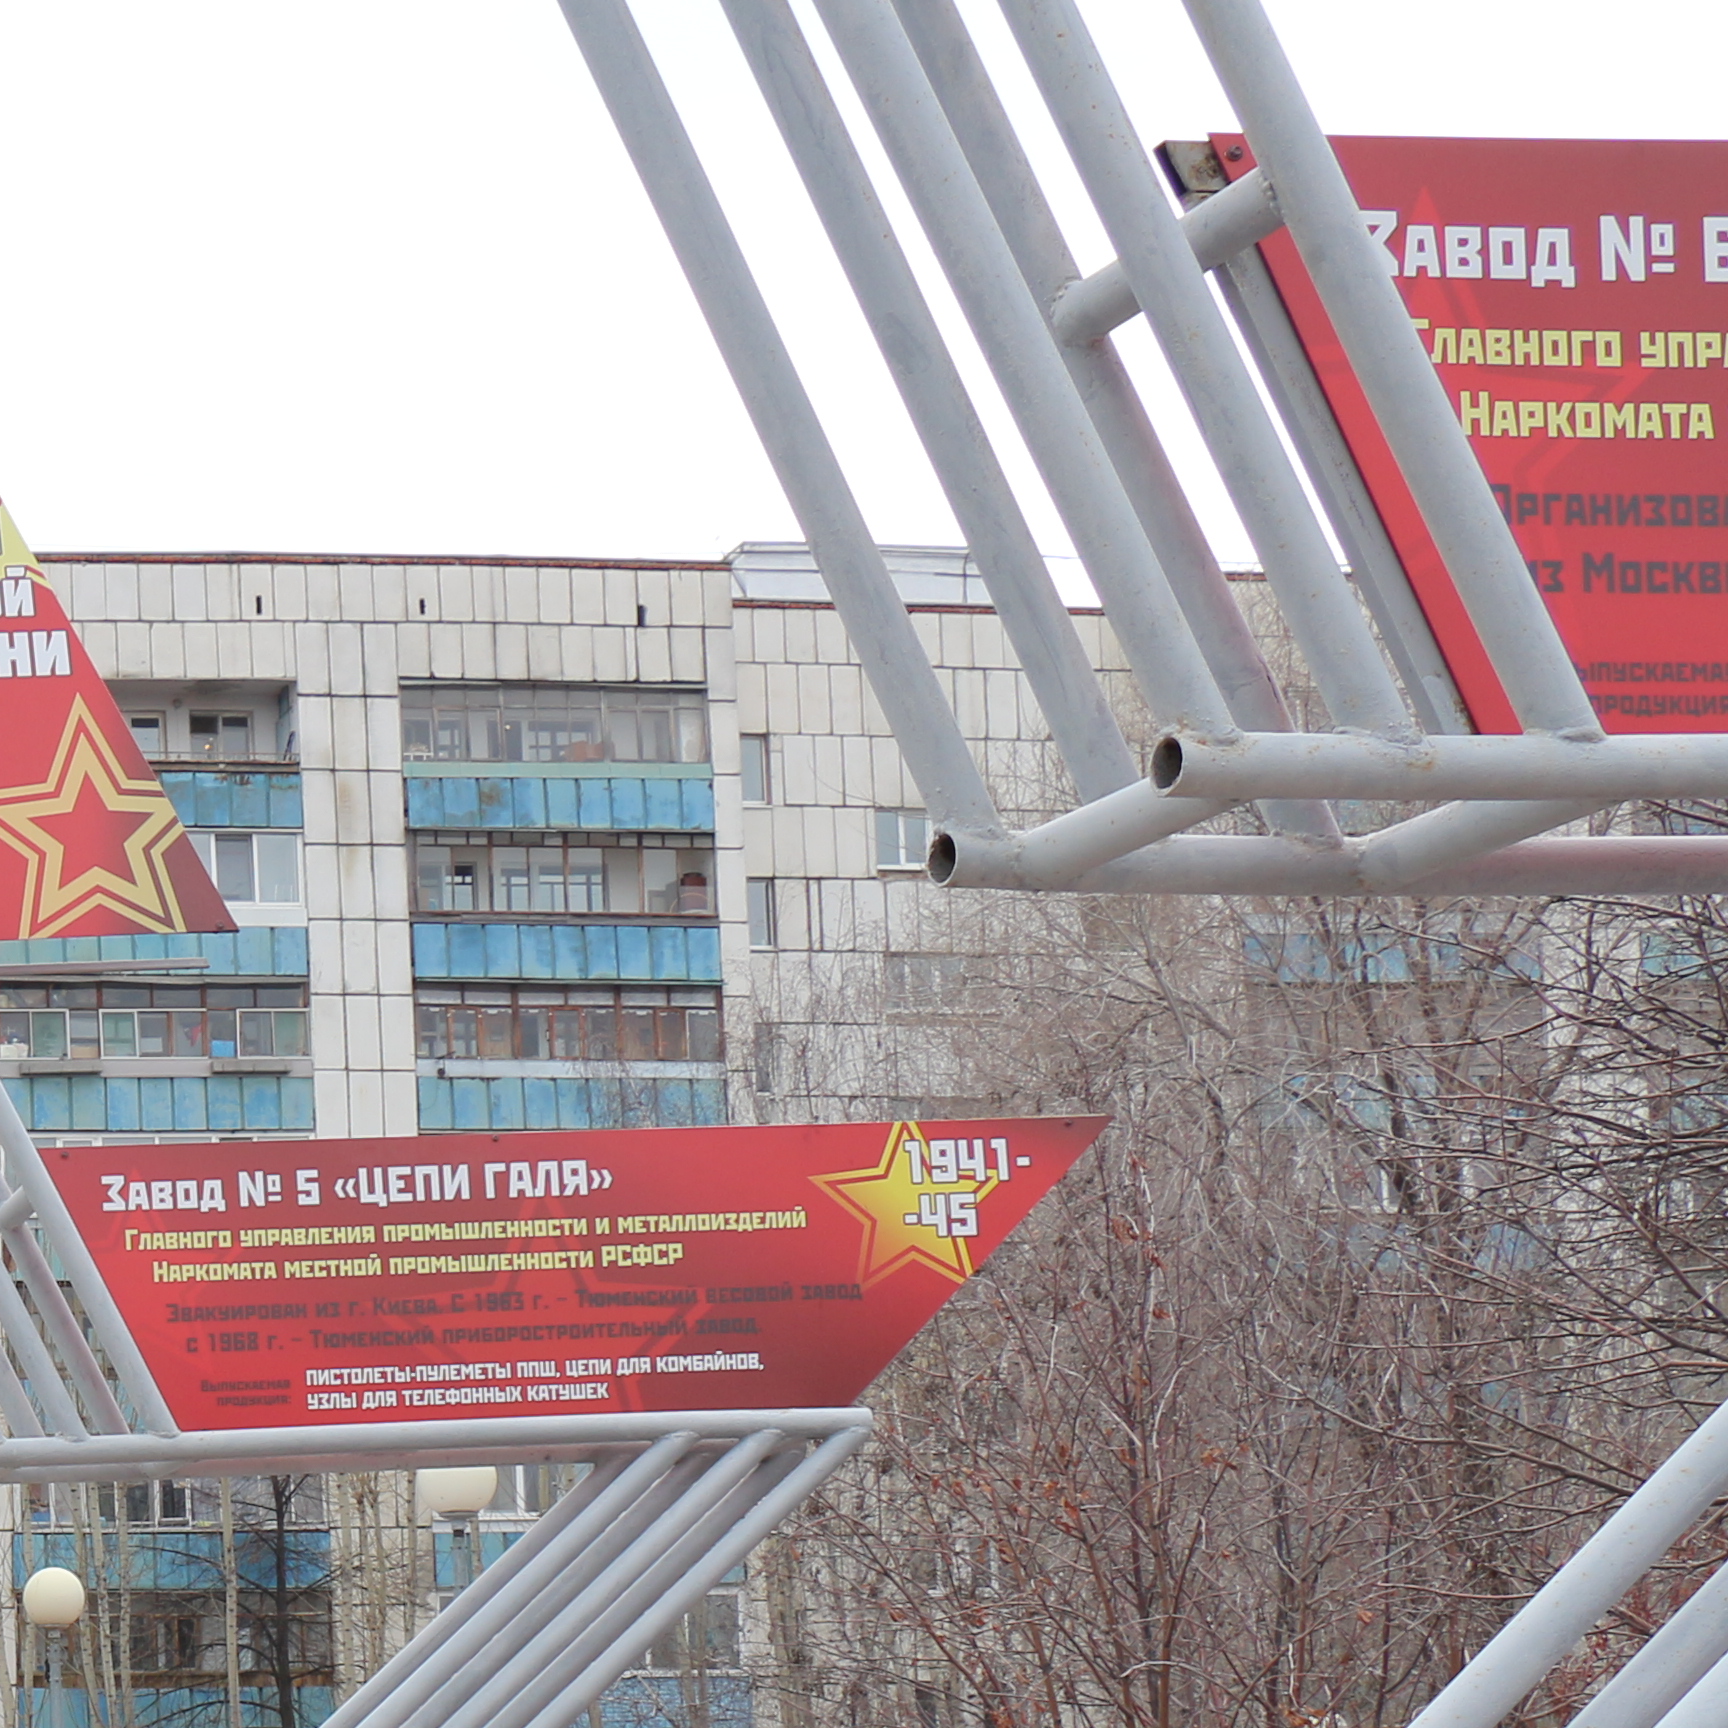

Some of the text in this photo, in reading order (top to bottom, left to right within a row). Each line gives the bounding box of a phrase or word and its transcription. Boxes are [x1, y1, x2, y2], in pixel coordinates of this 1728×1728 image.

[1599, 214, 1676, 281] №
[1410, 317, 1728, 368] лавного упр
[1460, 390, 1715, 439] Наркомата
[1490, 484, 1728, 527] рганизов
[1582, 552, 1728, 594] Москв
[1574, 662, 1728, 682] ыпускаема
[101, 1158, 612, 1216] Завод № 5 «ЦЕПИ ГАЛЯ»
[125, 1206, 806, 1251] Главного управления промышленности и металлоизделий
[153, 1242, 683, 1283] Наркомата местной промышленности РСФСР
[165, 1302, 307, 1323] Эвакуирован
[315, 1301, 341, 1318] из
[574, 1285, 698, 1309] Тюменский
[208, 1331, 259, 1352] 1968
[309, 1325, 435, 1349] Тюменский
[306, 1349, 764, 1386] ПИСТОЛЕТЫ-ПУЛЕМЕТЫ ППШ, ЦЕПИ ДЛЯ КОМБАЙНОВ,
[307, 1382, 609, 1410] УЗЛЫ ДЛЯ ТЕЛЕФОННЫХ КАТУШЕК
